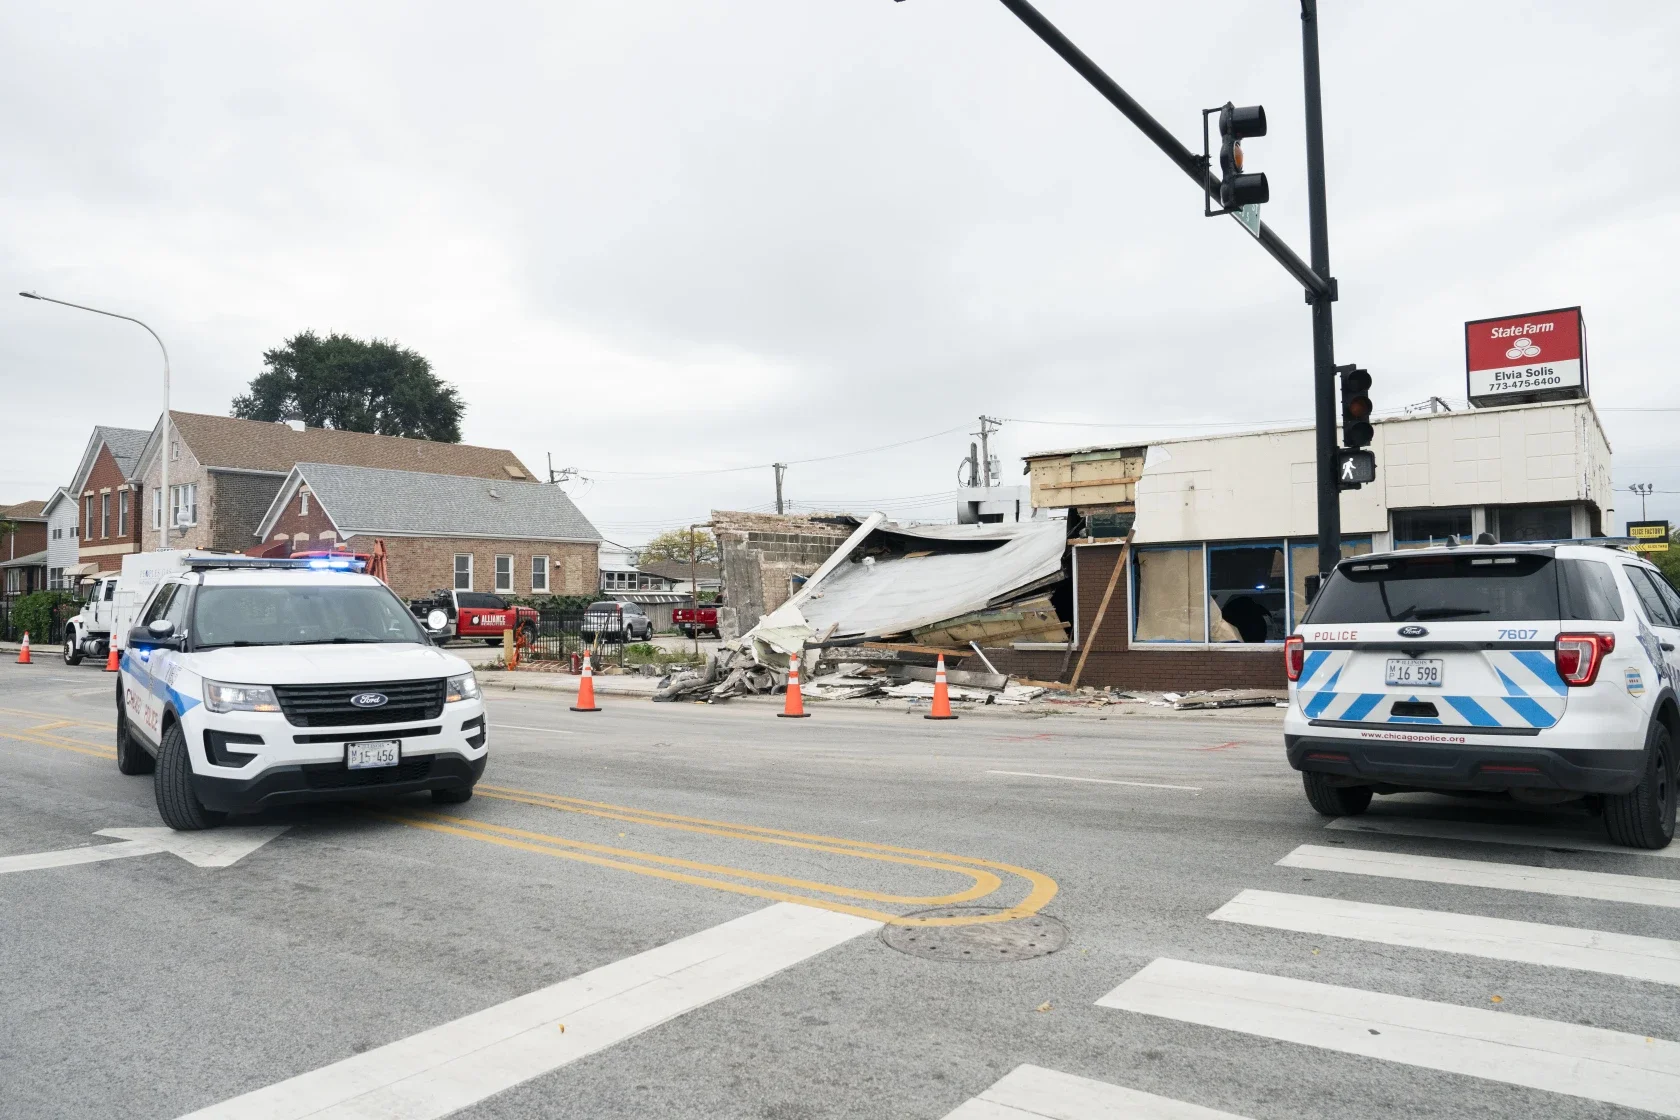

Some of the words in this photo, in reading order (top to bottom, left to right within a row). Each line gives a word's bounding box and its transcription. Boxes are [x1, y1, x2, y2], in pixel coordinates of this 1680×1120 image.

[1495, 370, 1522, 382] Elvia
[1525, 367, 1554, 378] Solis
[1489, 376, 1561, 391] 773-475-6400
[481, 614, 506, 622] ALLIANCE
[1314, 630, 1358, 641] POLICE
[1497, 629, 1539, 640] 7607
[1402, 626, 1422, 635] Ford
[1397, 666, 1411, 681] 16
[1417, 666, 1438, 682] 598
[359, 695, 381, 704] Ford
[1361, 731, 1466, 743] www.chicagopolice.org
[359, 750, 371, 764] 15
[377, 749, 394, 762] 456
